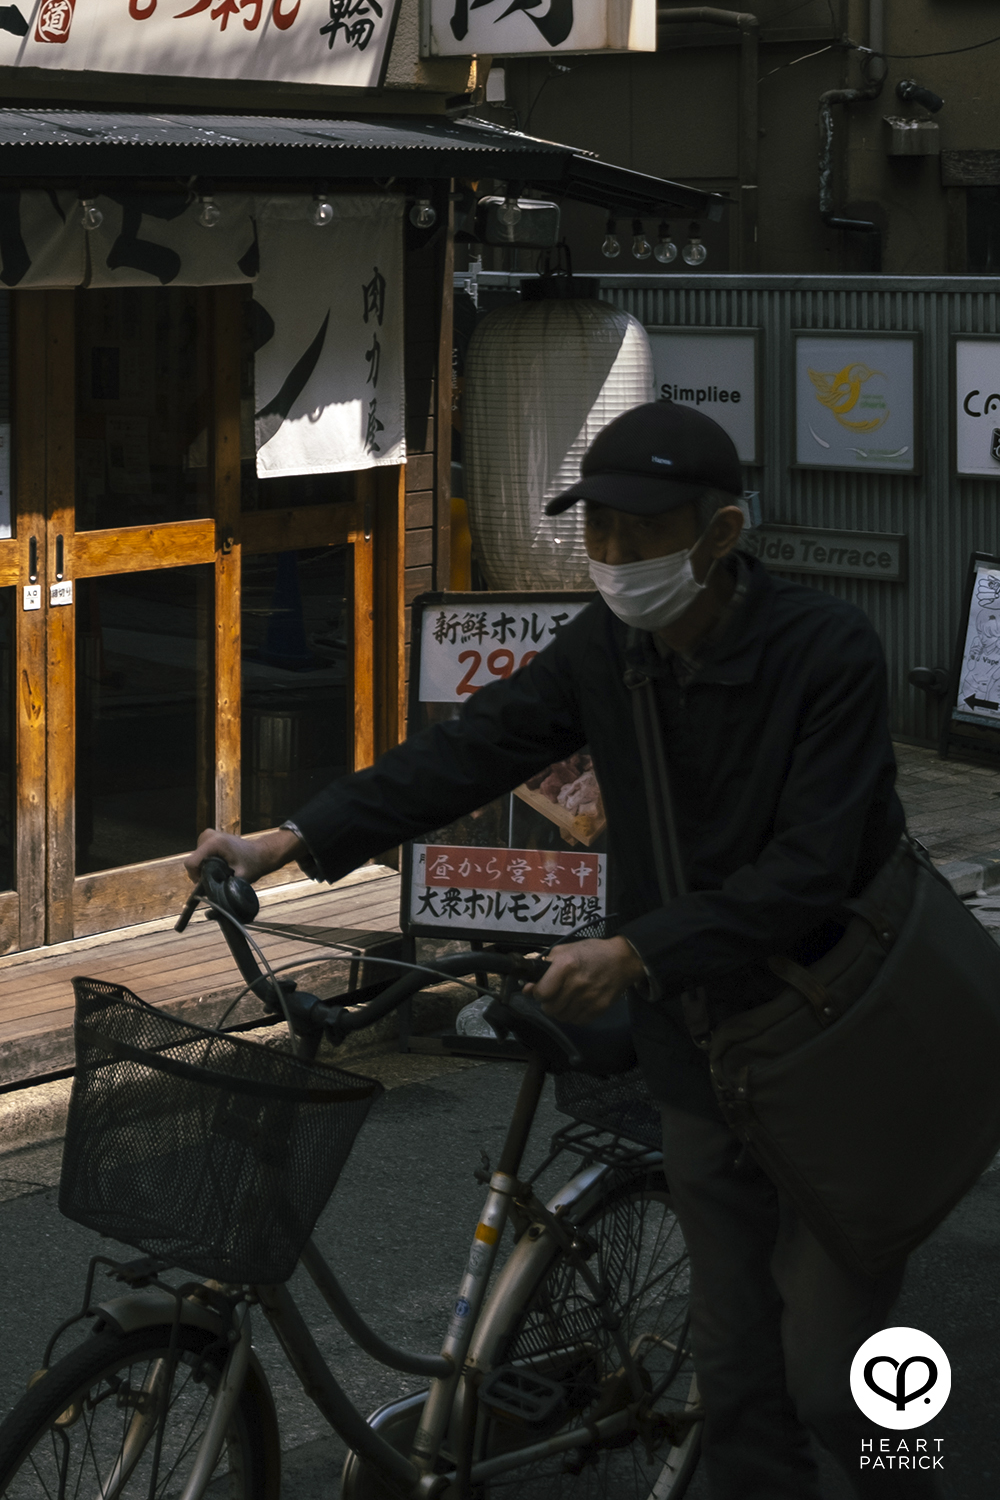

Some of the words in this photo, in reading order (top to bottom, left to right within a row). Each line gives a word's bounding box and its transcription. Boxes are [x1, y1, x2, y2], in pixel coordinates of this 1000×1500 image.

[660, 382, 742, 407] Simpliee
[800, 539, 893, 569] Terrace
[429, 852, 594, 888] 昼から営業中
[417, 884, 603, 929] 大衆ホルモン酒場
